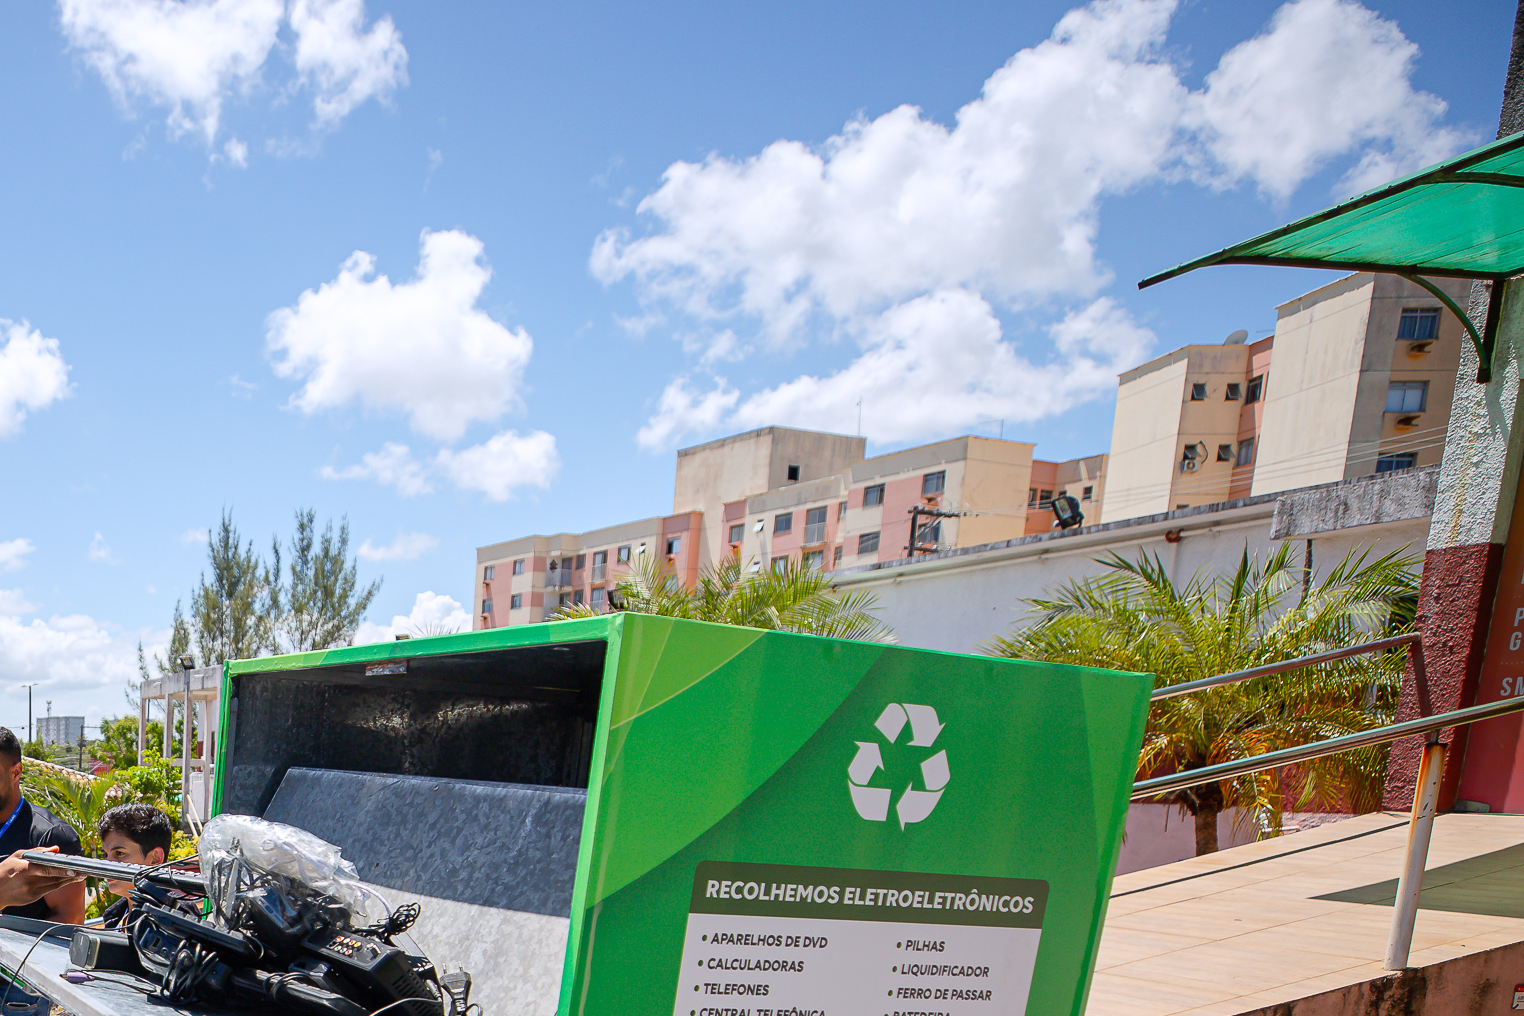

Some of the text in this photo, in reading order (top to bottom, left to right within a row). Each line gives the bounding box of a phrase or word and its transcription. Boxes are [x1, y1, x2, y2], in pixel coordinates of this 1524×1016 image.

[706, 880, 1034, 913] RECOLHEMOS ELETROELETRÔNICOS
[711, 933, 828, 948] APARELHOS DE DVD
[906, 940, 945, 952] PILHAS
[708, 958, 804, 972] CALCULADORAS
[901, 964, 989, 977] LIQUIDIFICADOR
[704, 983, 769, 996] TELEFONES
[897, 988, 992, 1001] FERRO DE PASSAR
